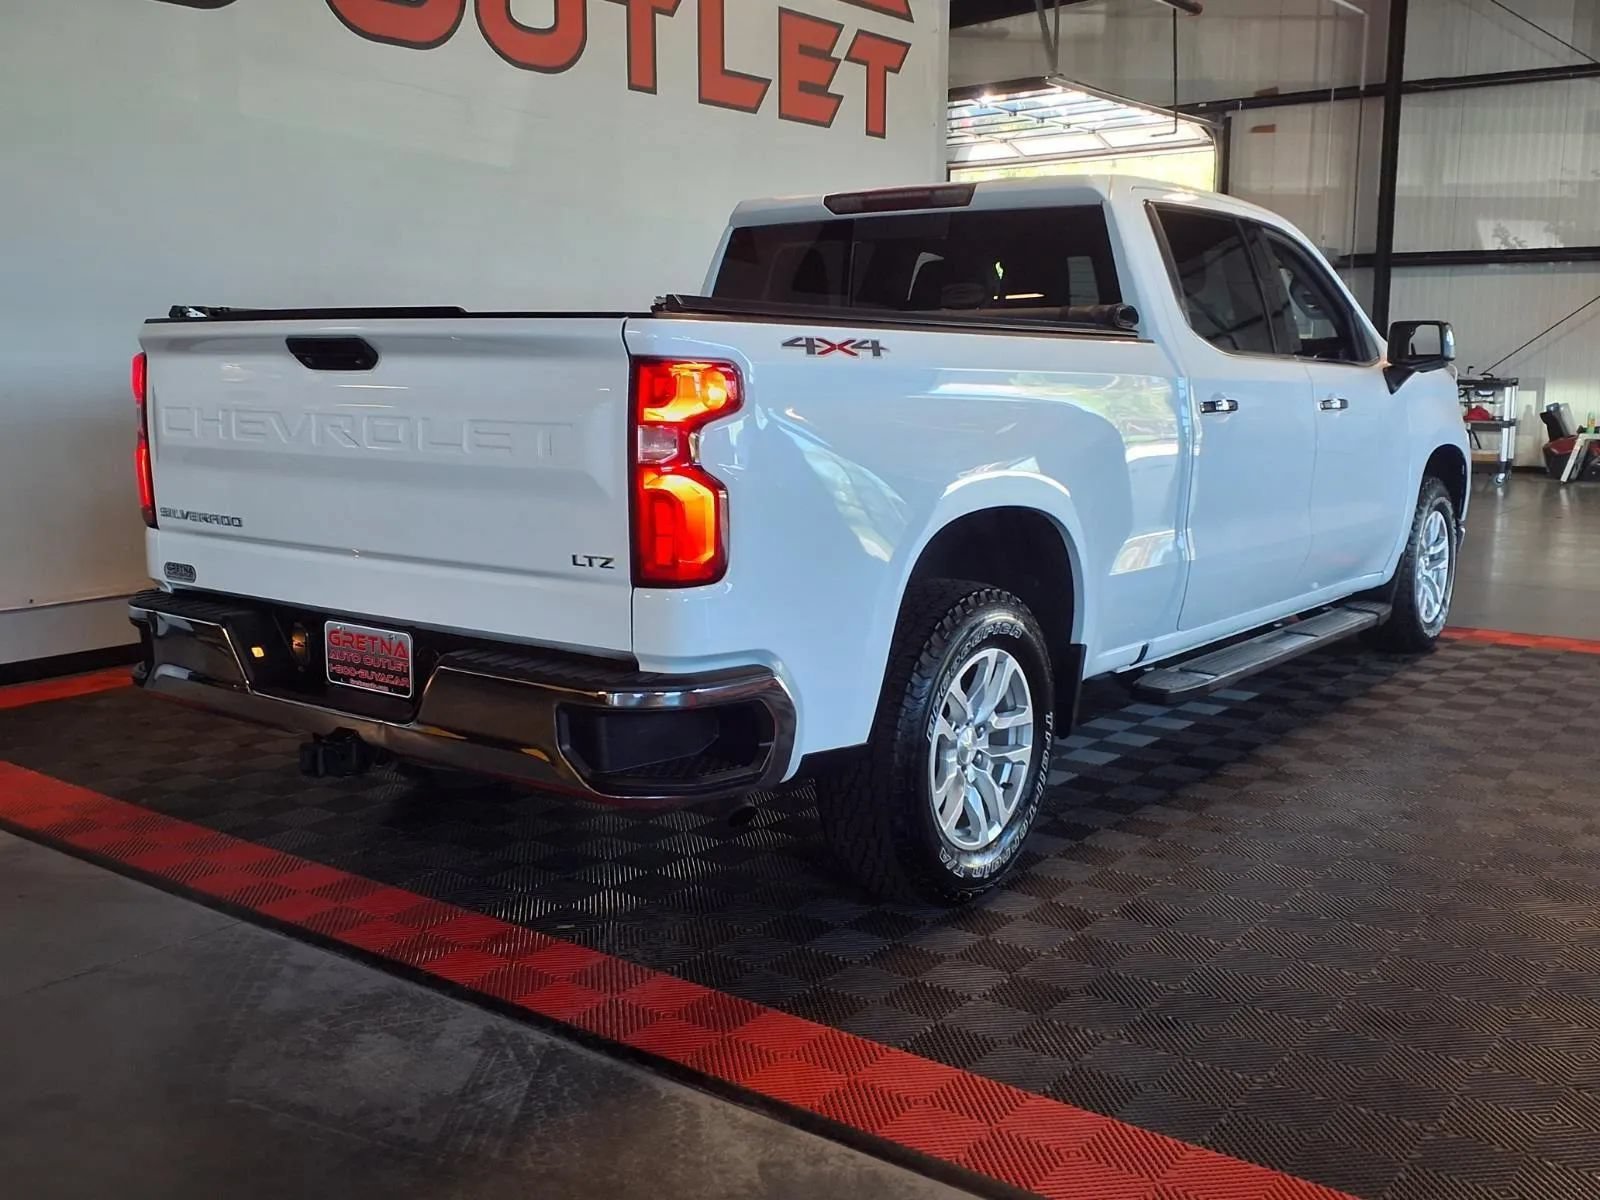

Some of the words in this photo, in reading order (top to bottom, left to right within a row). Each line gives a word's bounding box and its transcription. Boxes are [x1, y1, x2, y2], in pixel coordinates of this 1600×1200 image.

[160, 405, 574, 456] CHEVROLET
[159, 507, 243, 527] SILVERADO
[571, 554, 615, 569] LTZ
[328, 630, 408, 659] GRETNA
[328, 649, 361, 664] AUTO
[363, 655, 409, 673] OUTLET
